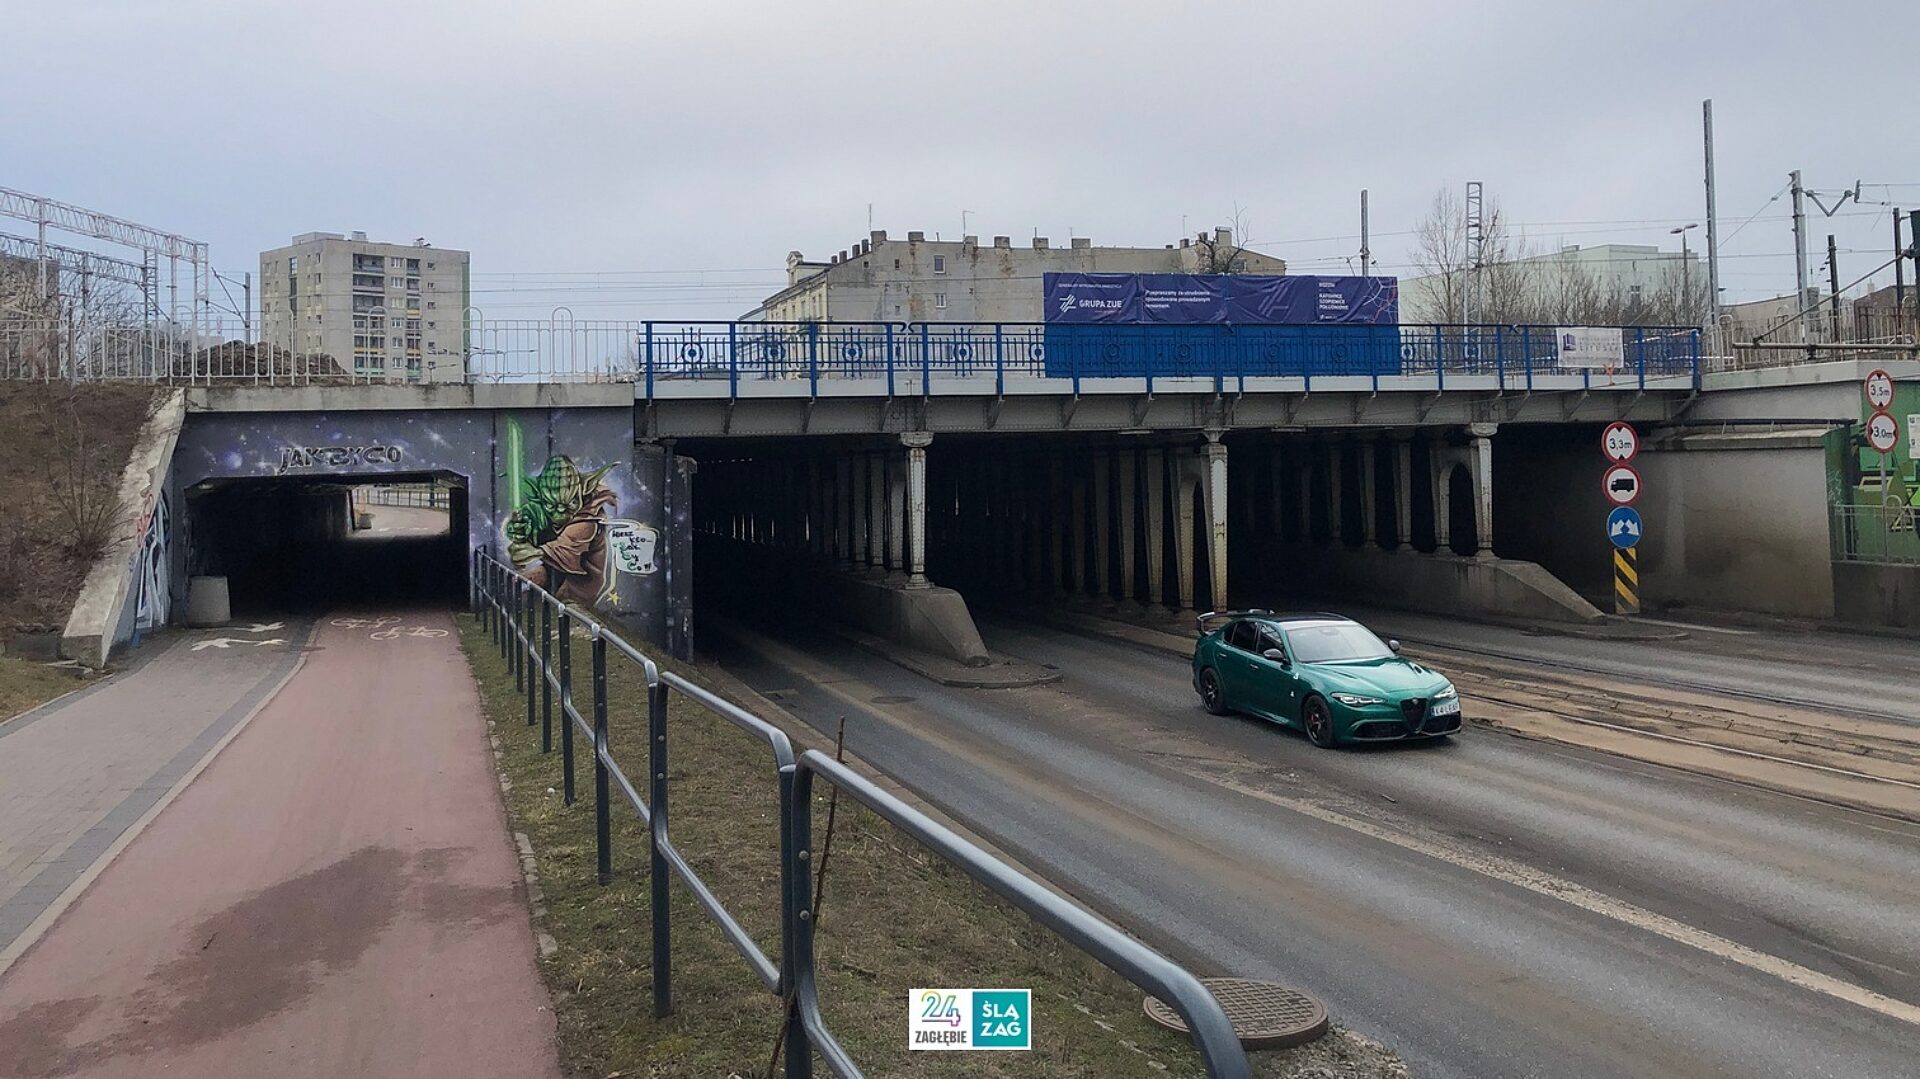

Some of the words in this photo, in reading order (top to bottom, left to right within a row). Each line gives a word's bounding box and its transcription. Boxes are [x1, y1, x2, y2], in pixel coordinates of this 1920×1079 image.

[1079, 300, 1105, 308] GRUPA
[1106, 300, 1122, 308] ZUE
[1870, 384, 1889, 397] 3,5m
[1609, 437, 1632, 450] 3,3m
